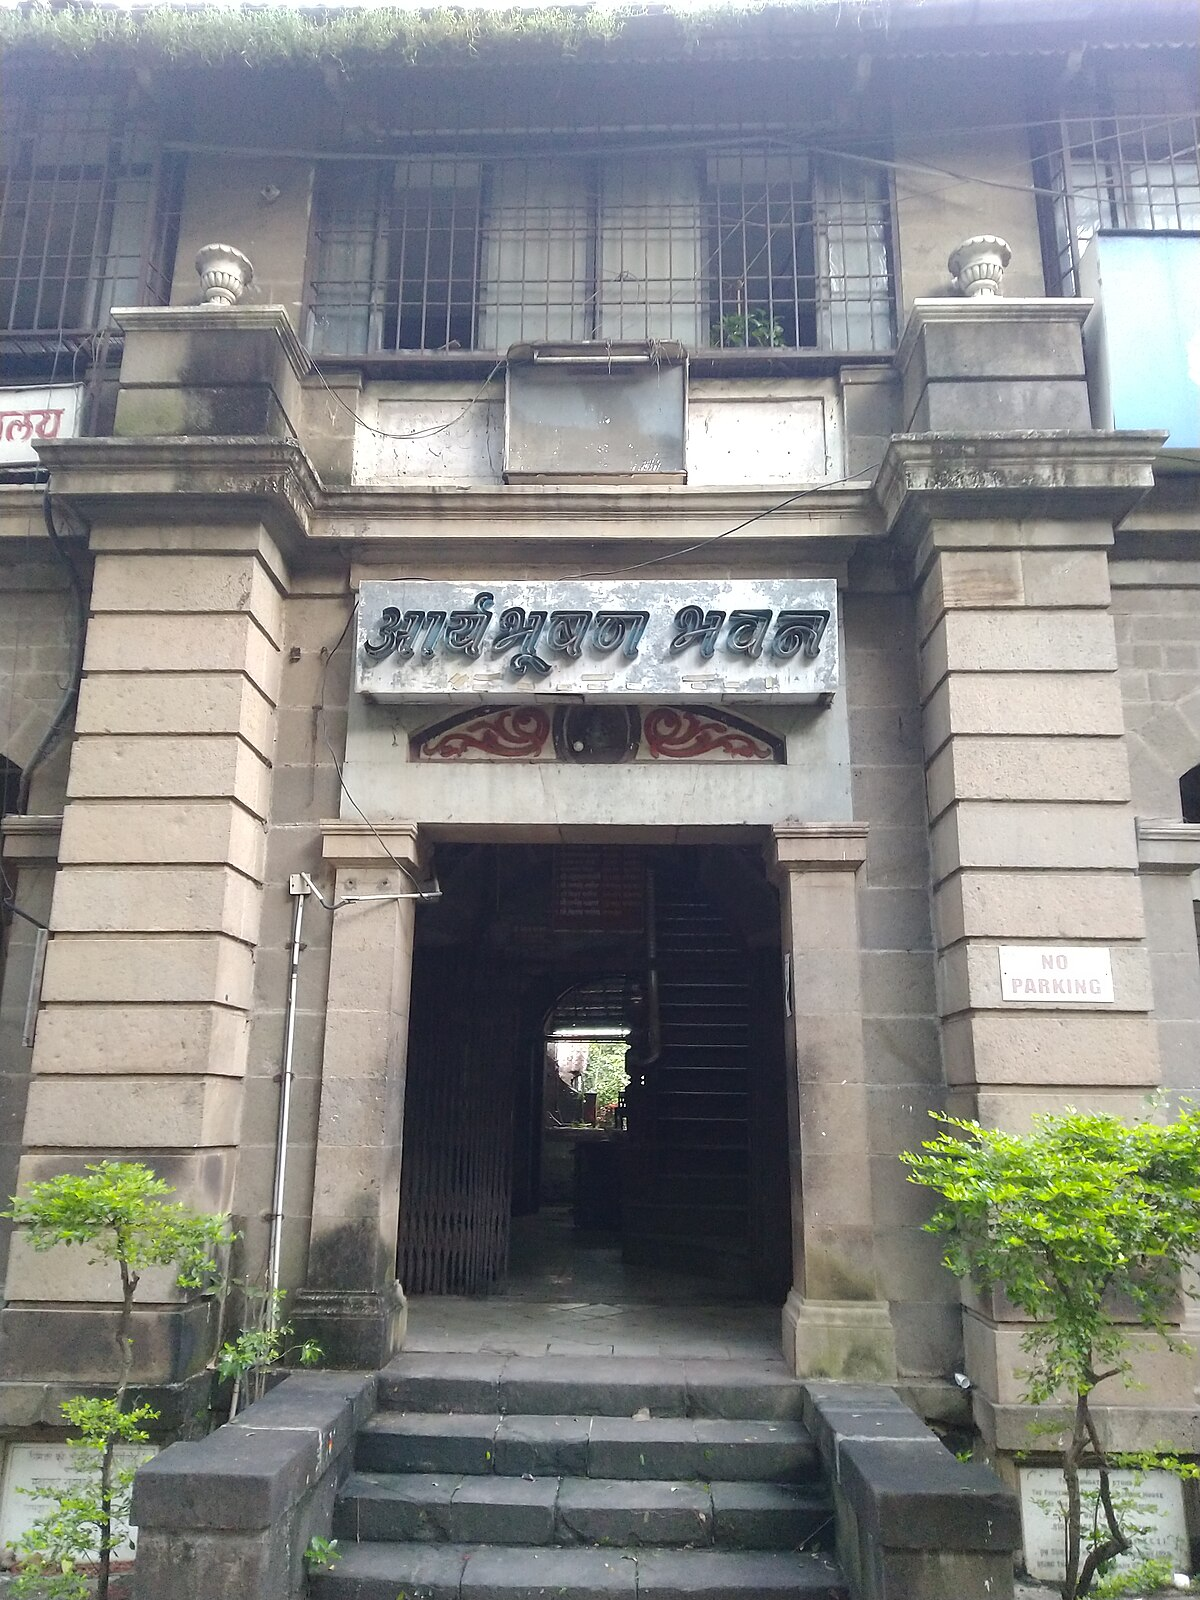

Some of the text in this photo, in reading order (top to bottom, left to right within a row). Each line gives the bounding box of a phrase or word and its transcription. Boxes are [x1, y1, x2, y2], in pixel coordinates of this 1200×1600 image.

[669, 605, 831, 659] भवन
[1041, 954, 1068, 970] NO
[1011, 978, 1101, 994] PARKING
